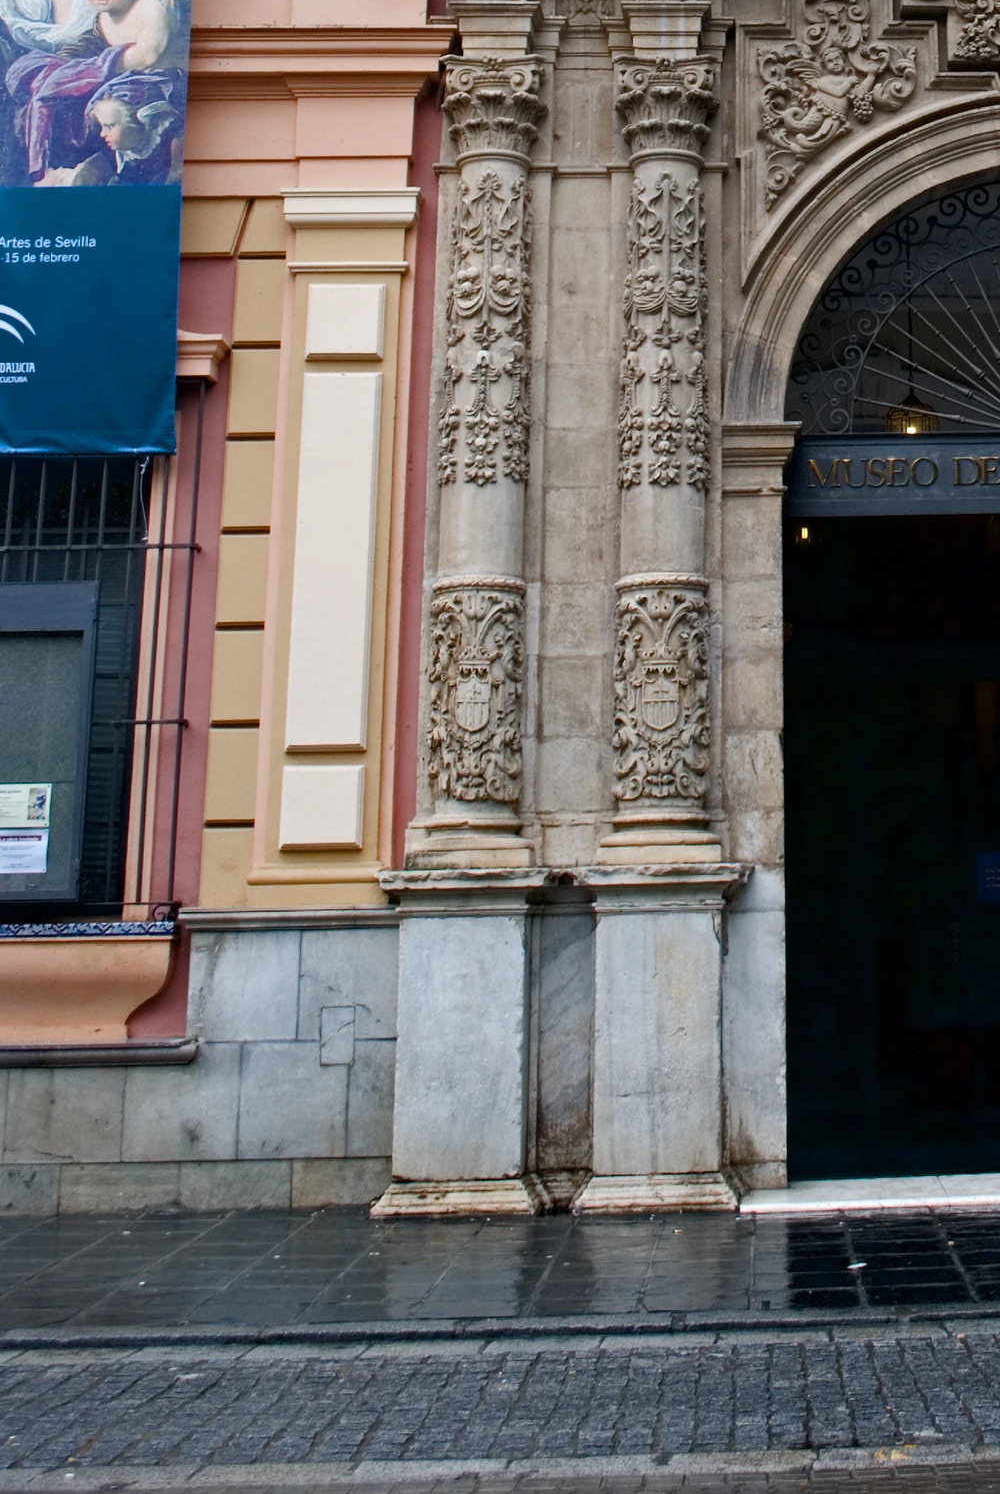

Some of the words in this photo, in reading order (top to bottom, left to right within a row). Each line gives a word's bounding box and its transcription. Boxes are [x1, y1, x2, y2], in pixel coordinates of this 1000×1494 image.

[34, 236, 51, 248] de
[55, 236, 97, 248] Sevilla
[22, 252, 36, 263] de
[39, 251, 80, 263] febrero
[807, 456, 939, 488] MUSEO
